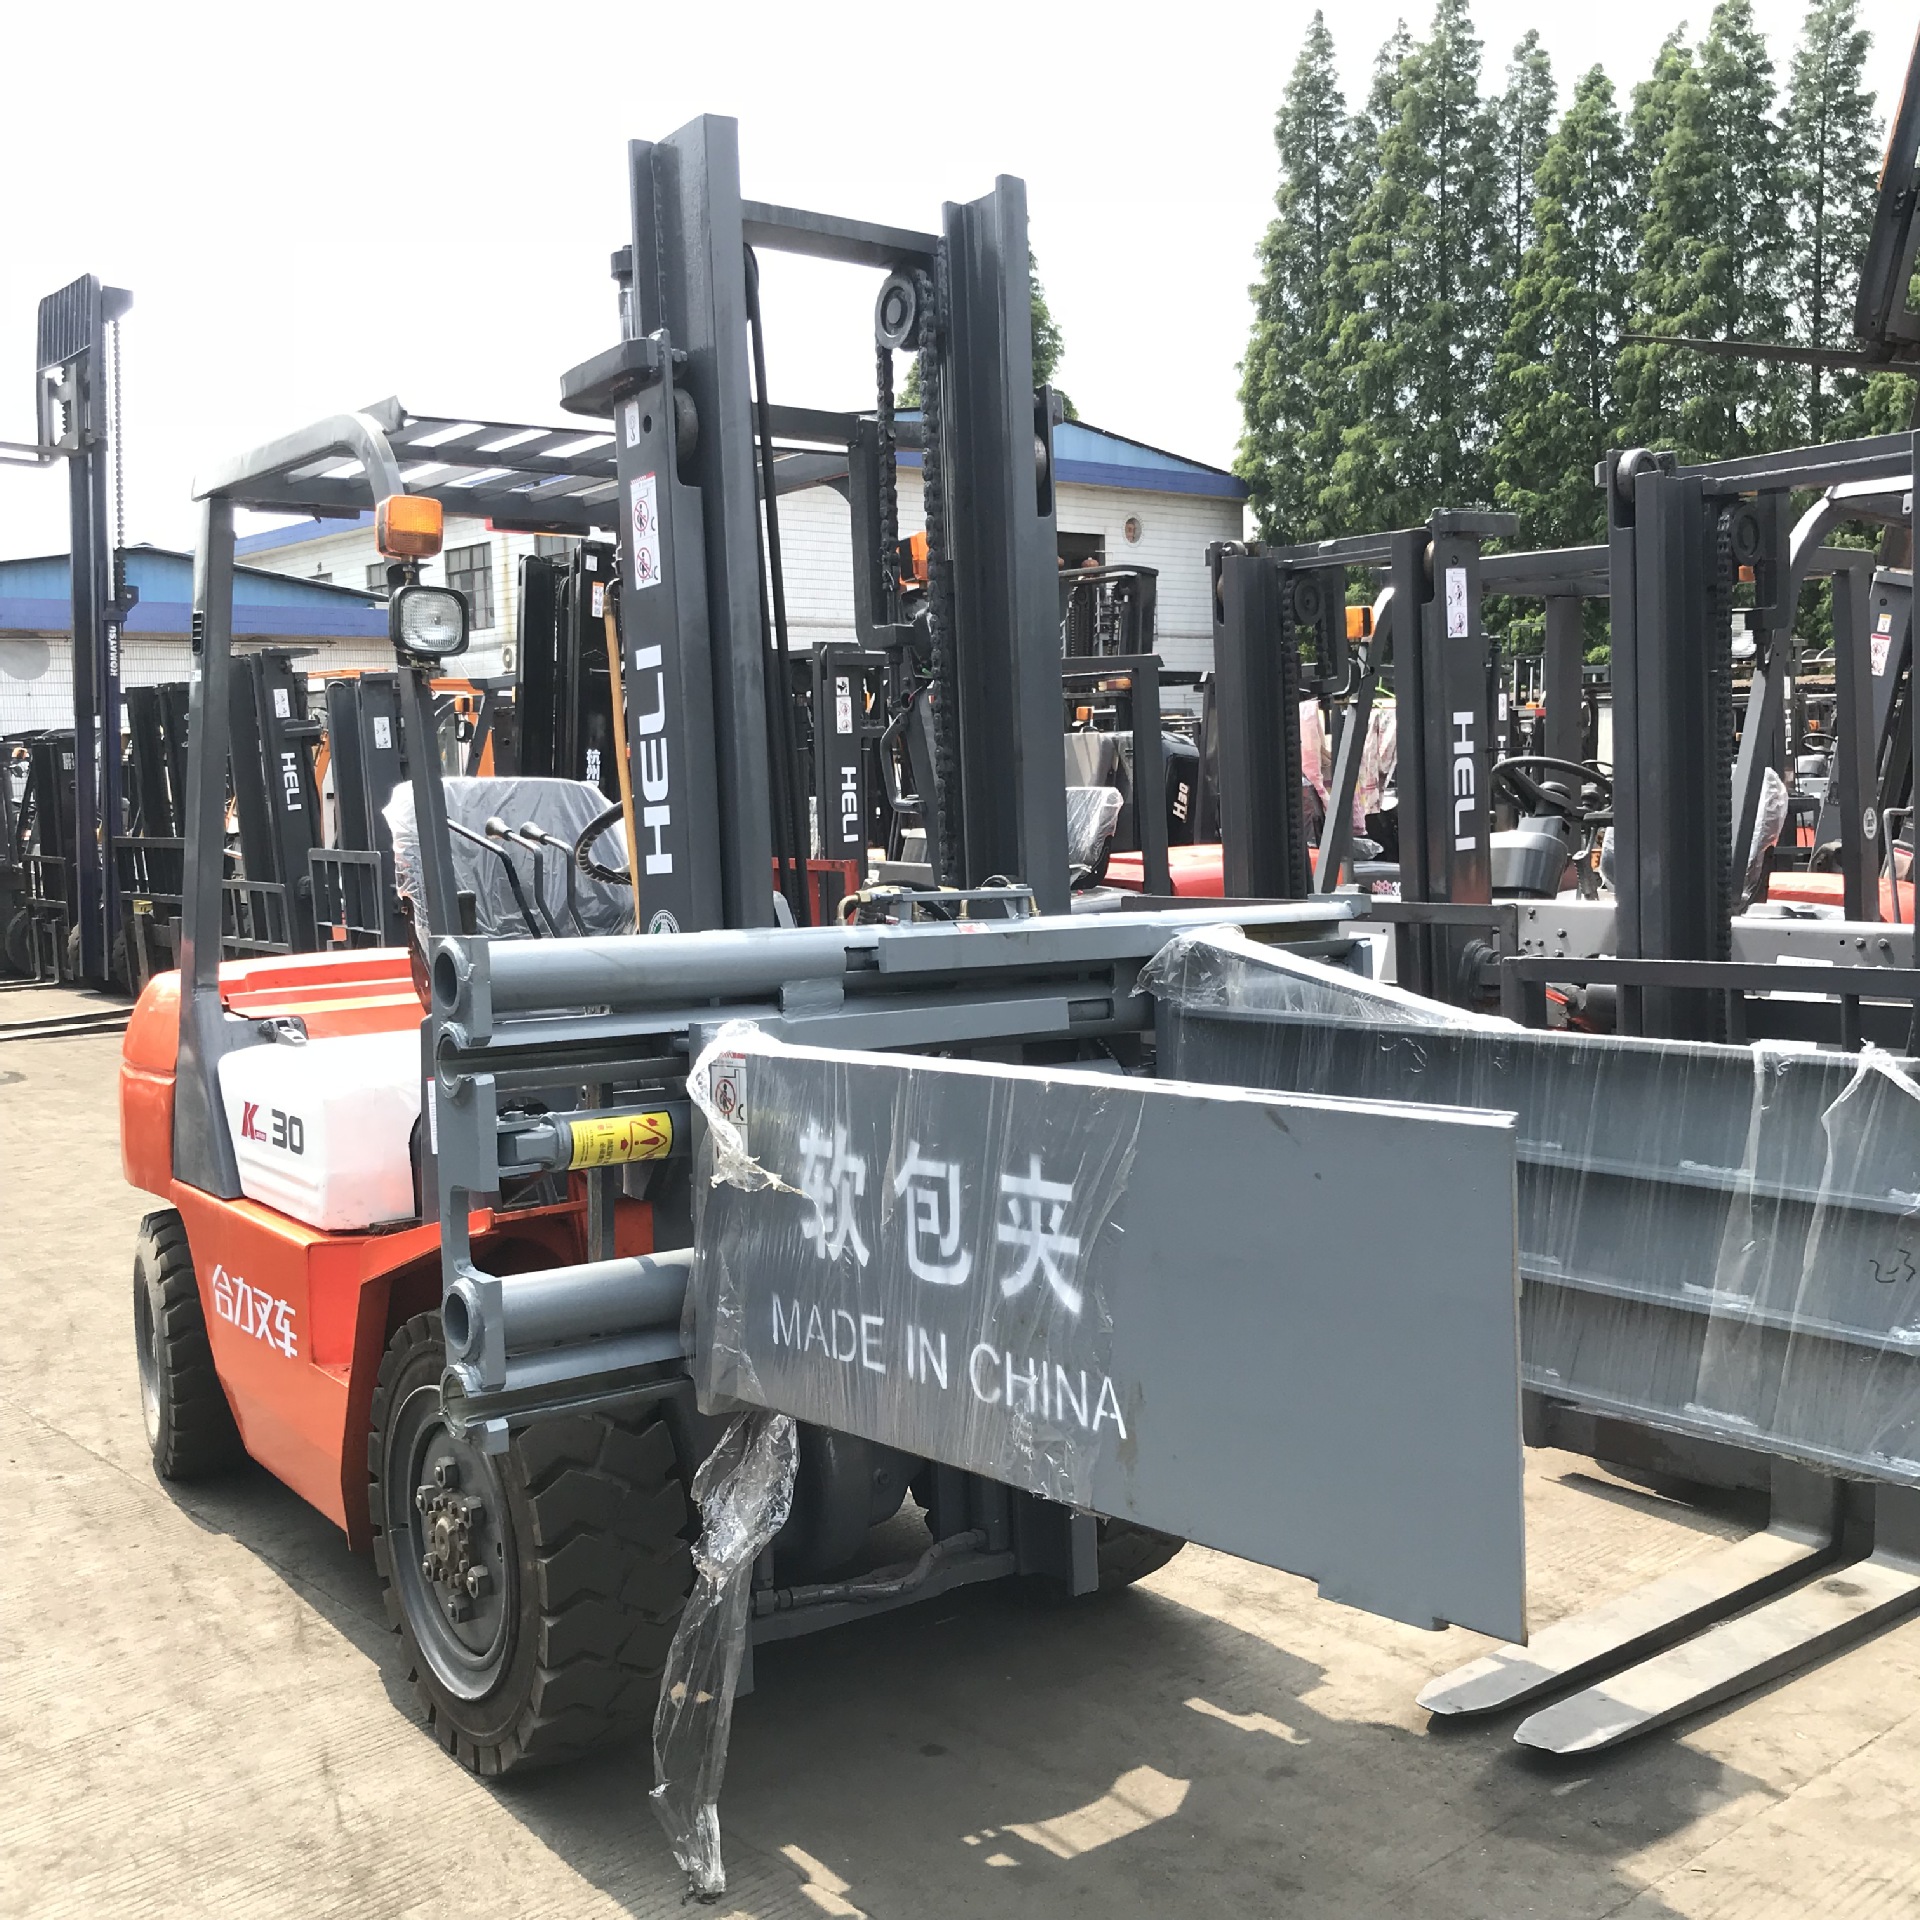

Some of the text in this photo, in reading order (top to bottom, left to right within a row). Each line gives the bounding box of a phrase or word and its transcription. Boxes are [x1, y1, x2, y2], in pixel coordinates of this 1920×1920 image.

[107, 625, 118, 677] KOMATSU
[635, 644, 673, 875] HELI
[1784, 709, 1792, 755] HELI
[281, 752, 302, 811] HELI
[841, 766, 859, 843] HELI
[1172, 781, 1189, 821] H30
[1453, 711, 1476, 851] HELI
[271, 1108, 304, 1155] 30
[800, 1120, 1082, 1313] 软包夹
[212, 1264, 298, 1358] 合力叉车
[771, 1294, 1128, 1439] MADE IN CHINA
